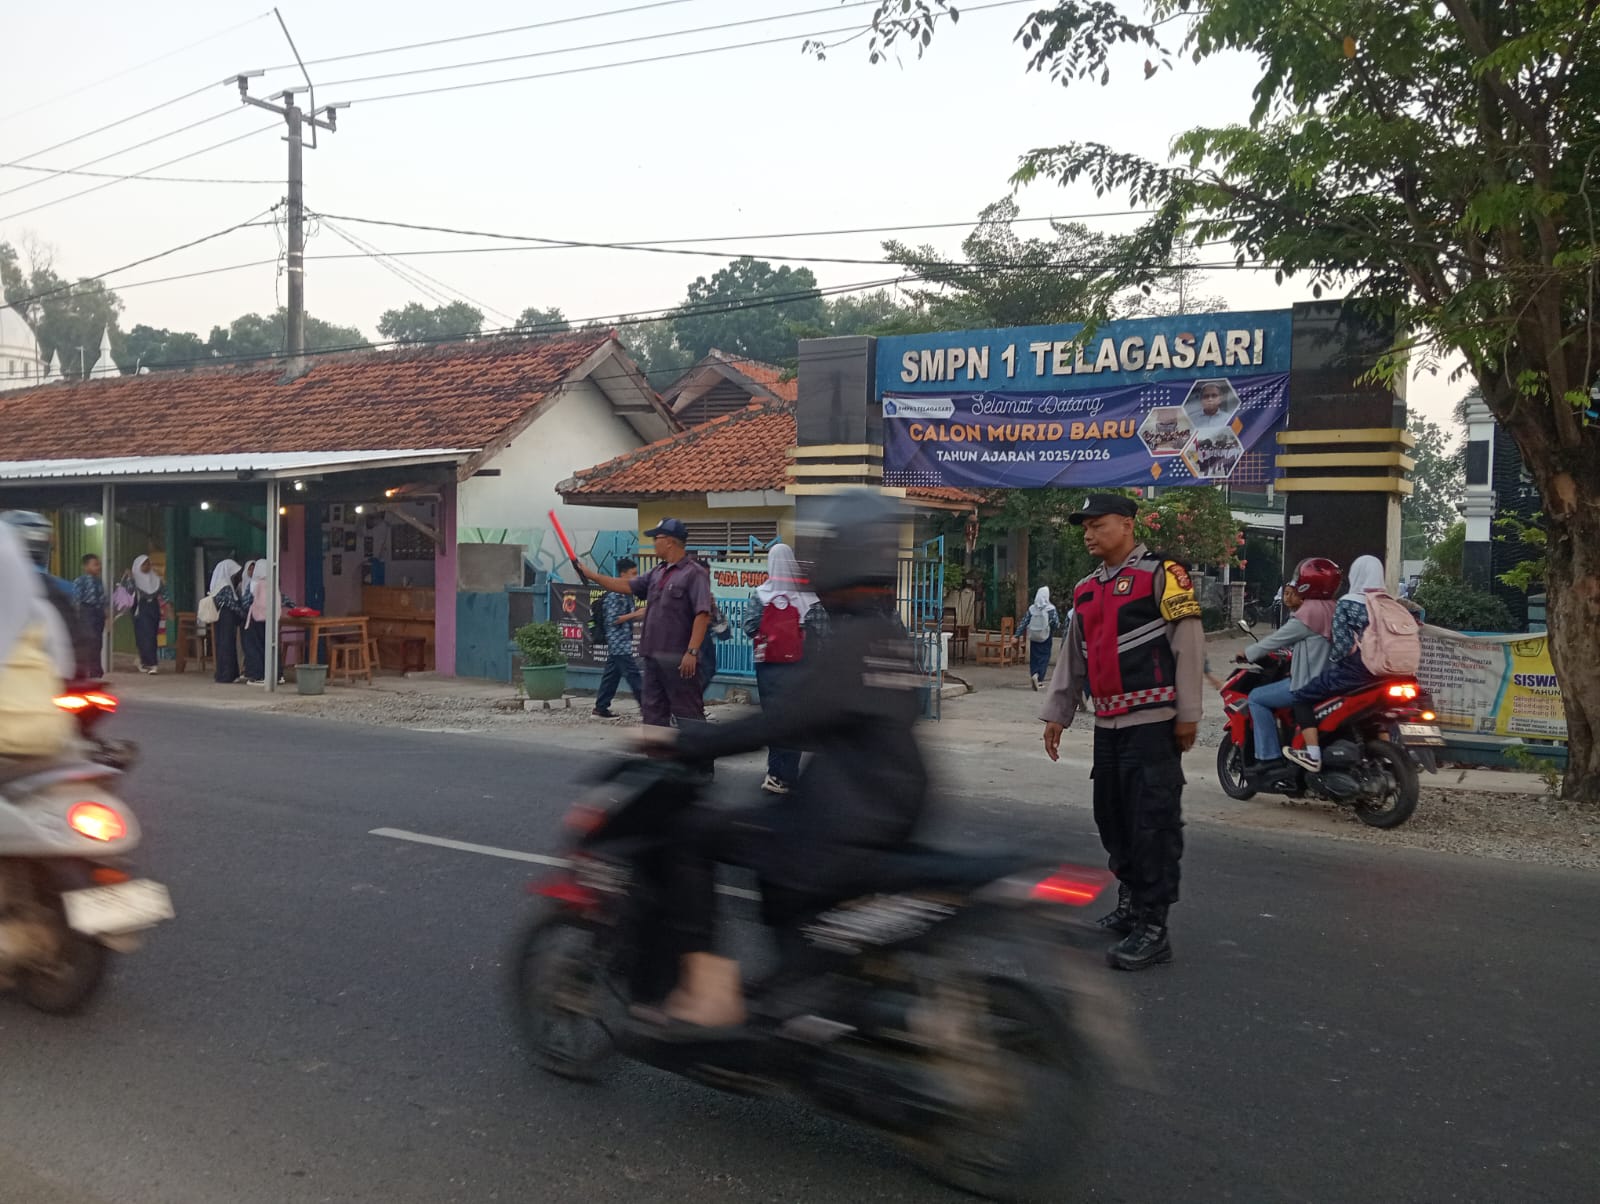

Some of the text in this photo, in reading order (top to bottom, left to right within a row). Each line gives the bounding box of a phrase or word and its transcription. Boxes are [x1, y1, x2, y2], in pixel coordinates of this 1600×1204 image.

[900, 328, 1264, 384] SMPN 1 TELAGASARI
[971, 393, 1104, 417] Selamat Datang
[909, 418, 1136, 442] CALON MURID BARU
[937, 449, 1111, 462] TAHUN AJARAN 2025/2026
[1513, 673, 1558, 687] SISWA
